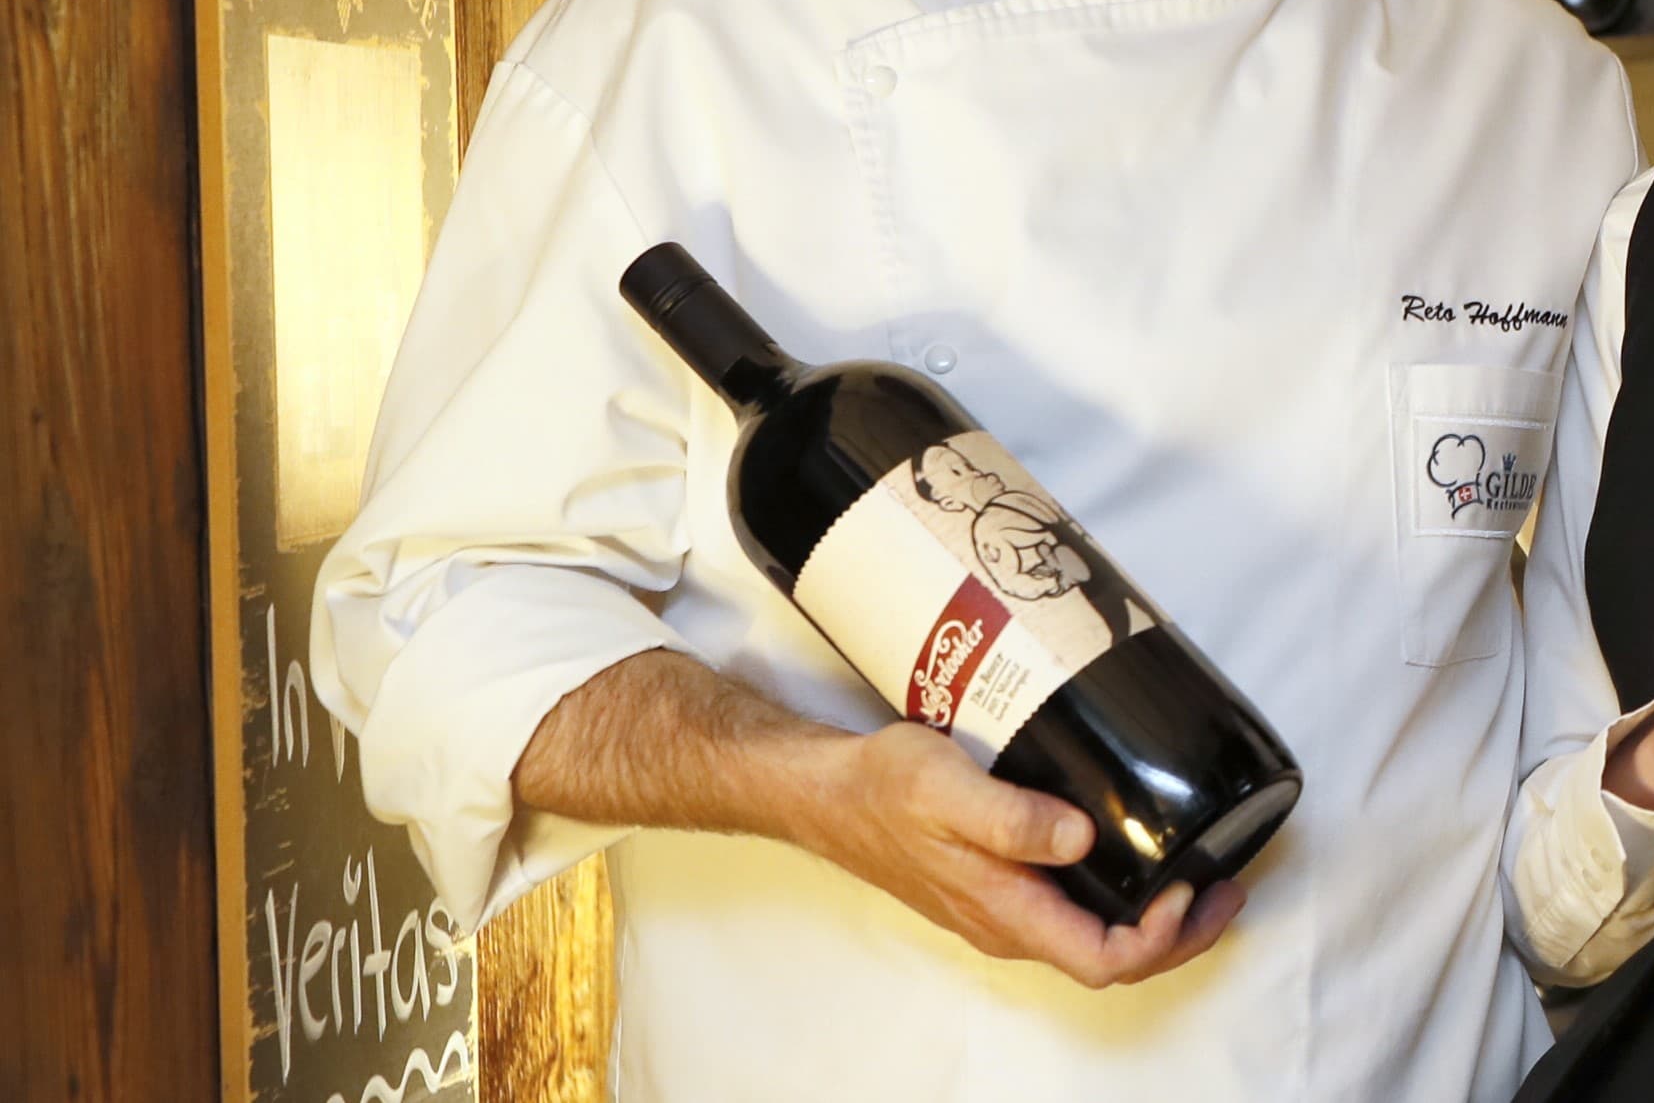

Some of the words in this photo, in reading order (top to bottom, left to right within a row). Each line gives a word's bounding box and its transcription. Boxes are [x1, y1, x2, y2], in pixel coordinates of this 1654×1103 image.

[1401, 294, 1457, 322] Reto
[1463, 301, 1569, 332] Hoffmann
[1486, 472, 1537, 500] GILDE
[265, 844, 461, 1086] Veritas
